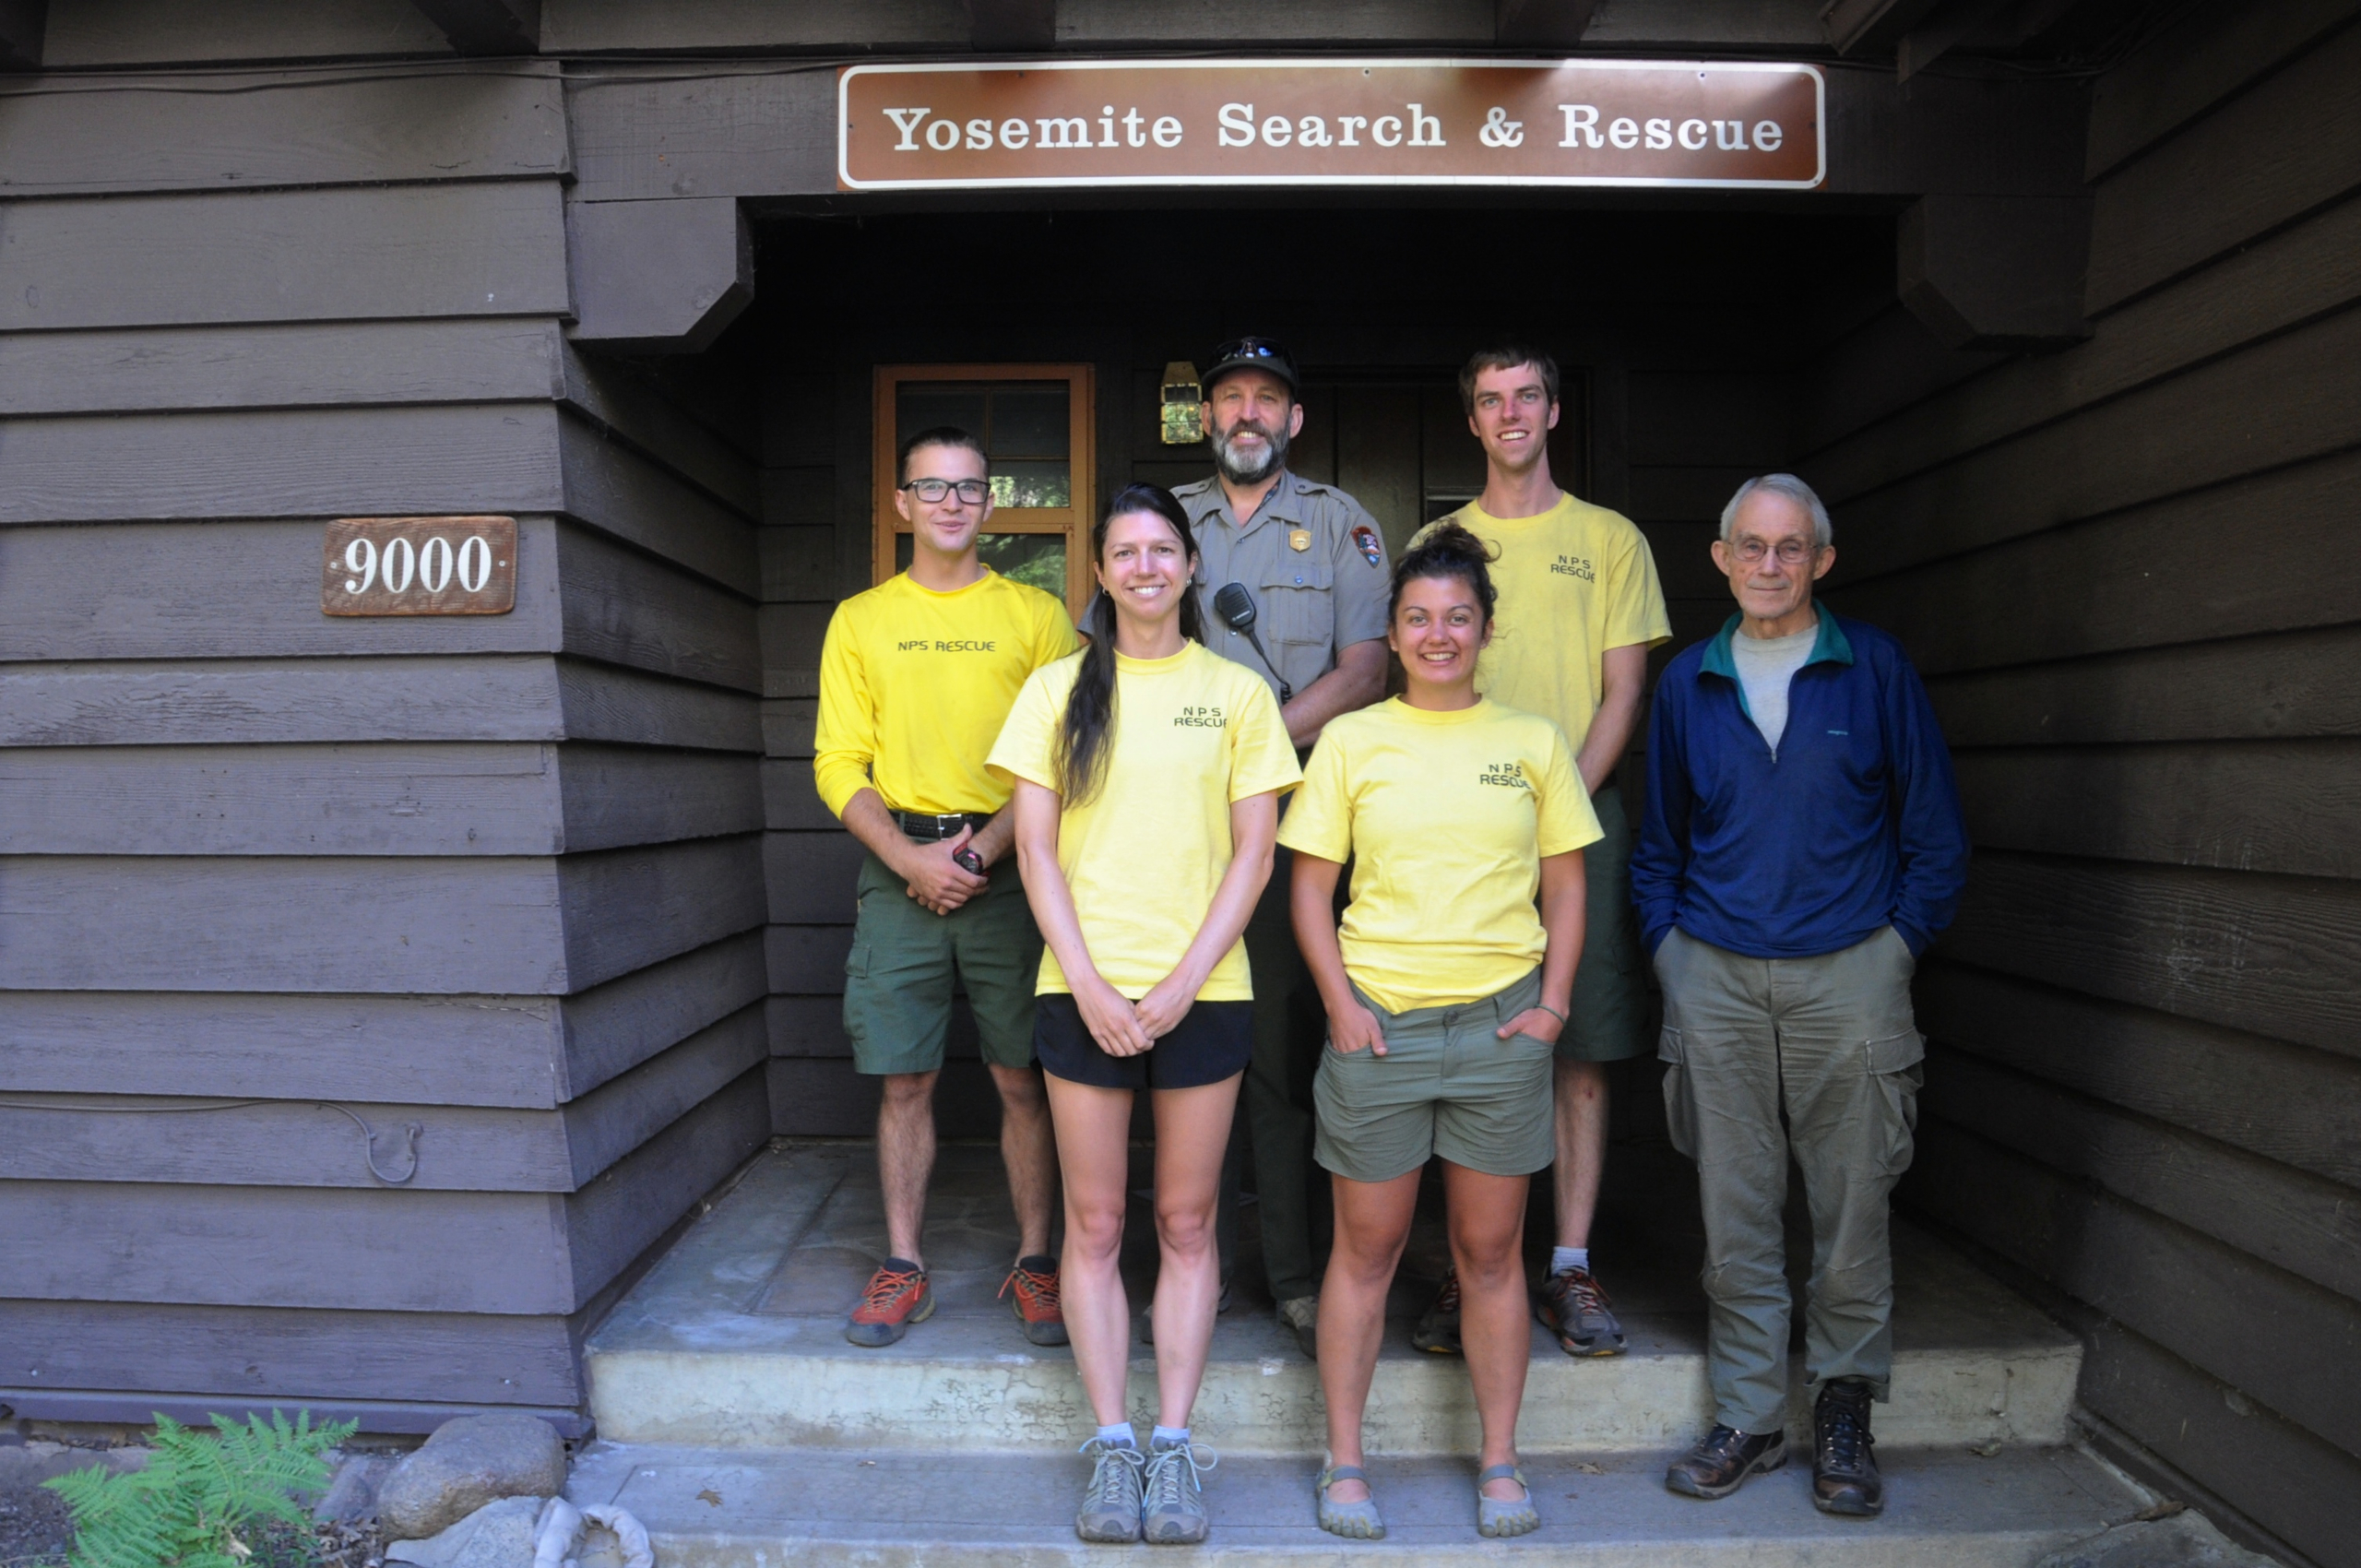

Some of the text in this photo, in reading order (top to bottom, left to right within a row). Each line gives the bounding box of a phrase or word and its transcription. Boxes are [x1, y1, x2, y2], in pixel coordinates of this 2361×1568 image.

[883, 102, 1783, 152] Yosemite Search & Rescue
[344, 535, 492, 595] 9000
[897, 640, 996, 652] NPS RESCUE
